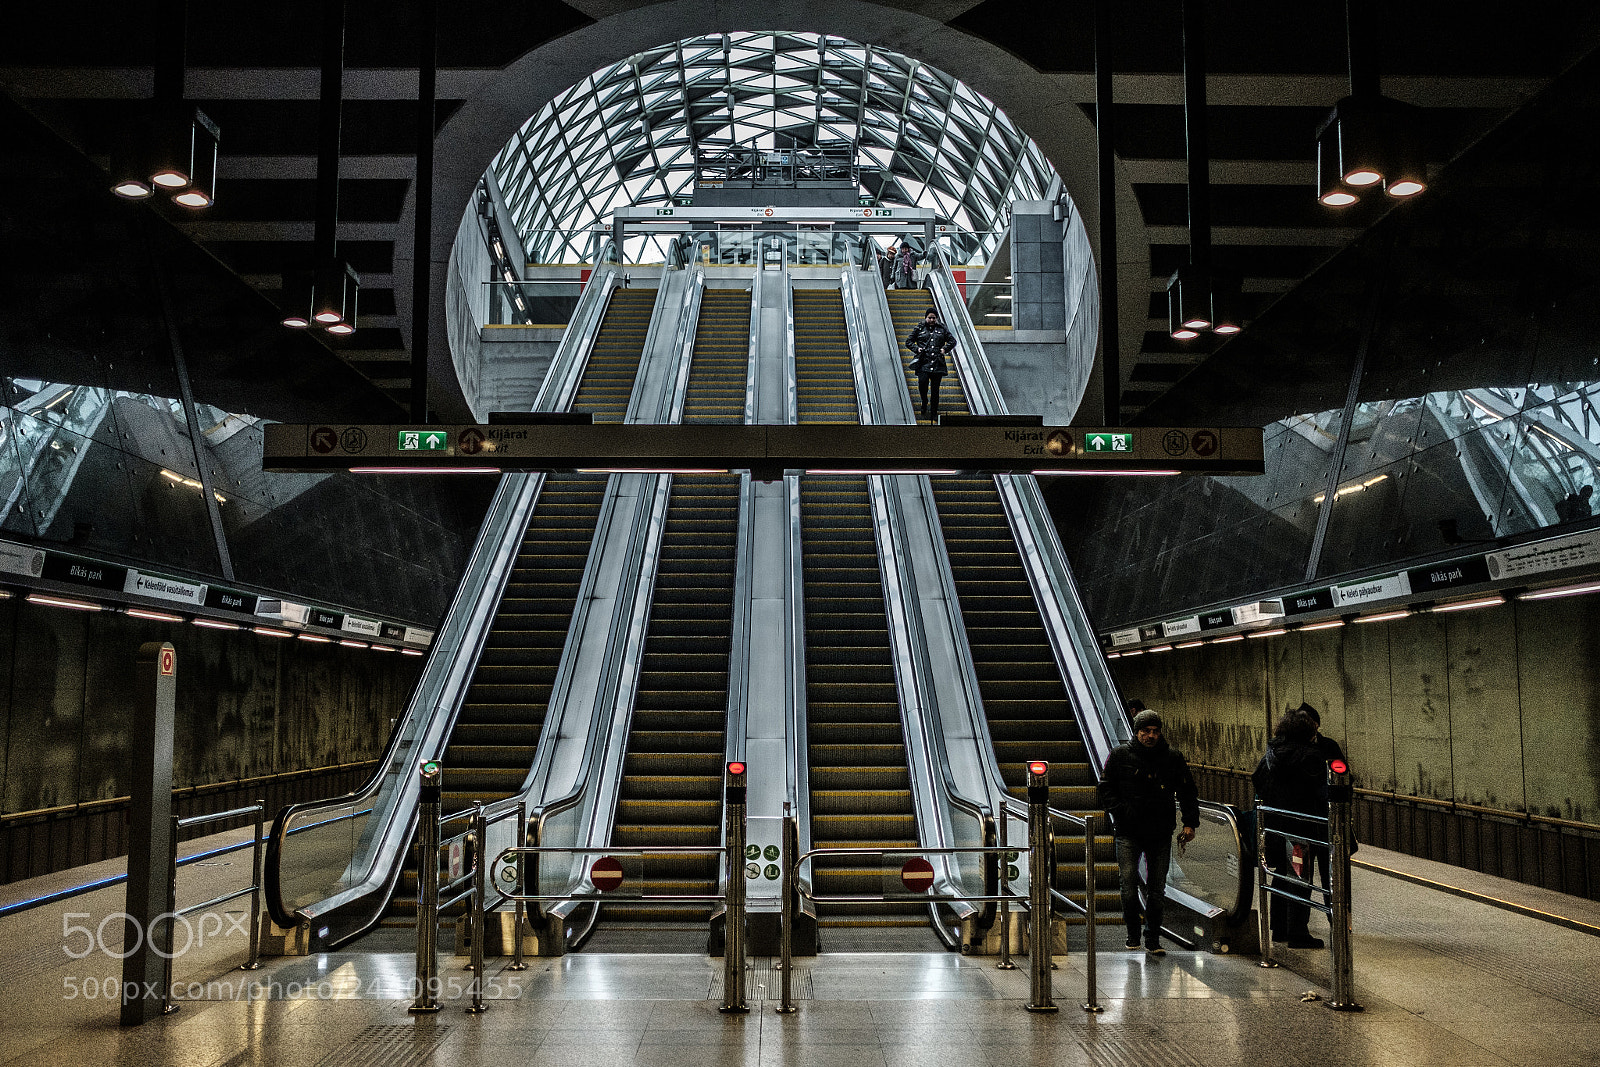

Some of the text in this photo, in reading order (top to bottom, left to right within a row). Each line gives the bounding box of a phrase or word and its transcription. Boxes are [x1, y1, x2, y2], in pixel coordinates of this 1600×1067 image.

[489, 429, 527, 442] Kijárat
[1004, 430, 1043, 442] Kijárat
[1024, 445, 1044, 455] Exit
[70, 565, 103, 582] Bikás park
[1430, 567, 1463, 583] Bikás park
